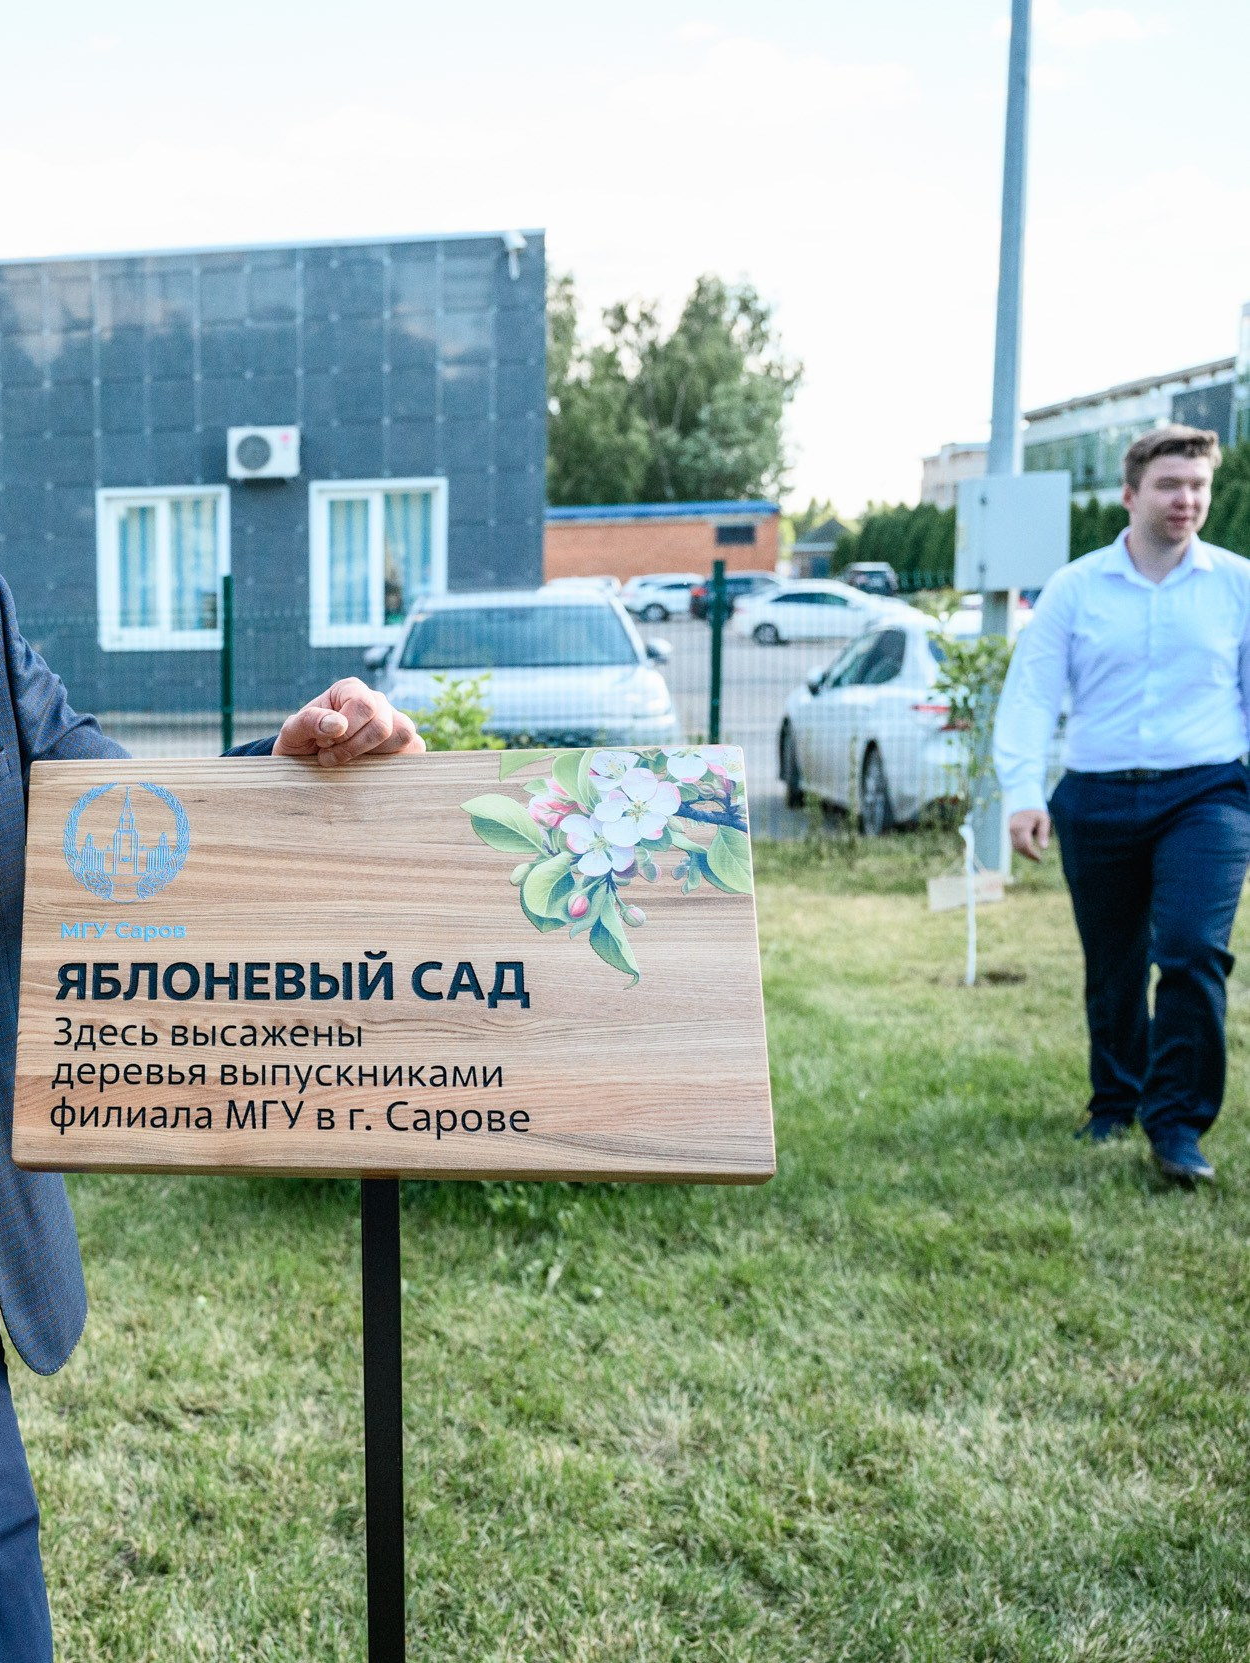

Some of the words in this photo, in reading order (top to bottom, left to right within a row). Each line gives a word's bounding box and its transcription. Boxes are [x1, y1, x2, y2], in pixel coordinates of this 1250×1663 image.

[60, 921, 110, 940] МГУ
[114, 921, 188, 943] Саров
[55, 950, 394, 1001] ЯБЛОНЕВЫЙ
[411, 960, 531, 1009] САД
[53, 1016, 159, 1052] Здесь
[171, 1024, 362, 1048] высажены
[51, 1063, 206, 1093] деревья
[220, 1064, 503, 1095] выпускниками
[50, 1095, 213, 1136] филиала
[226, 1099, 306, 1130] МГУ
[317, 1108, 336, 1130] в
[349, 1108, 372, 1131] г.
[386, 1100, 530, 1141] Сарове
